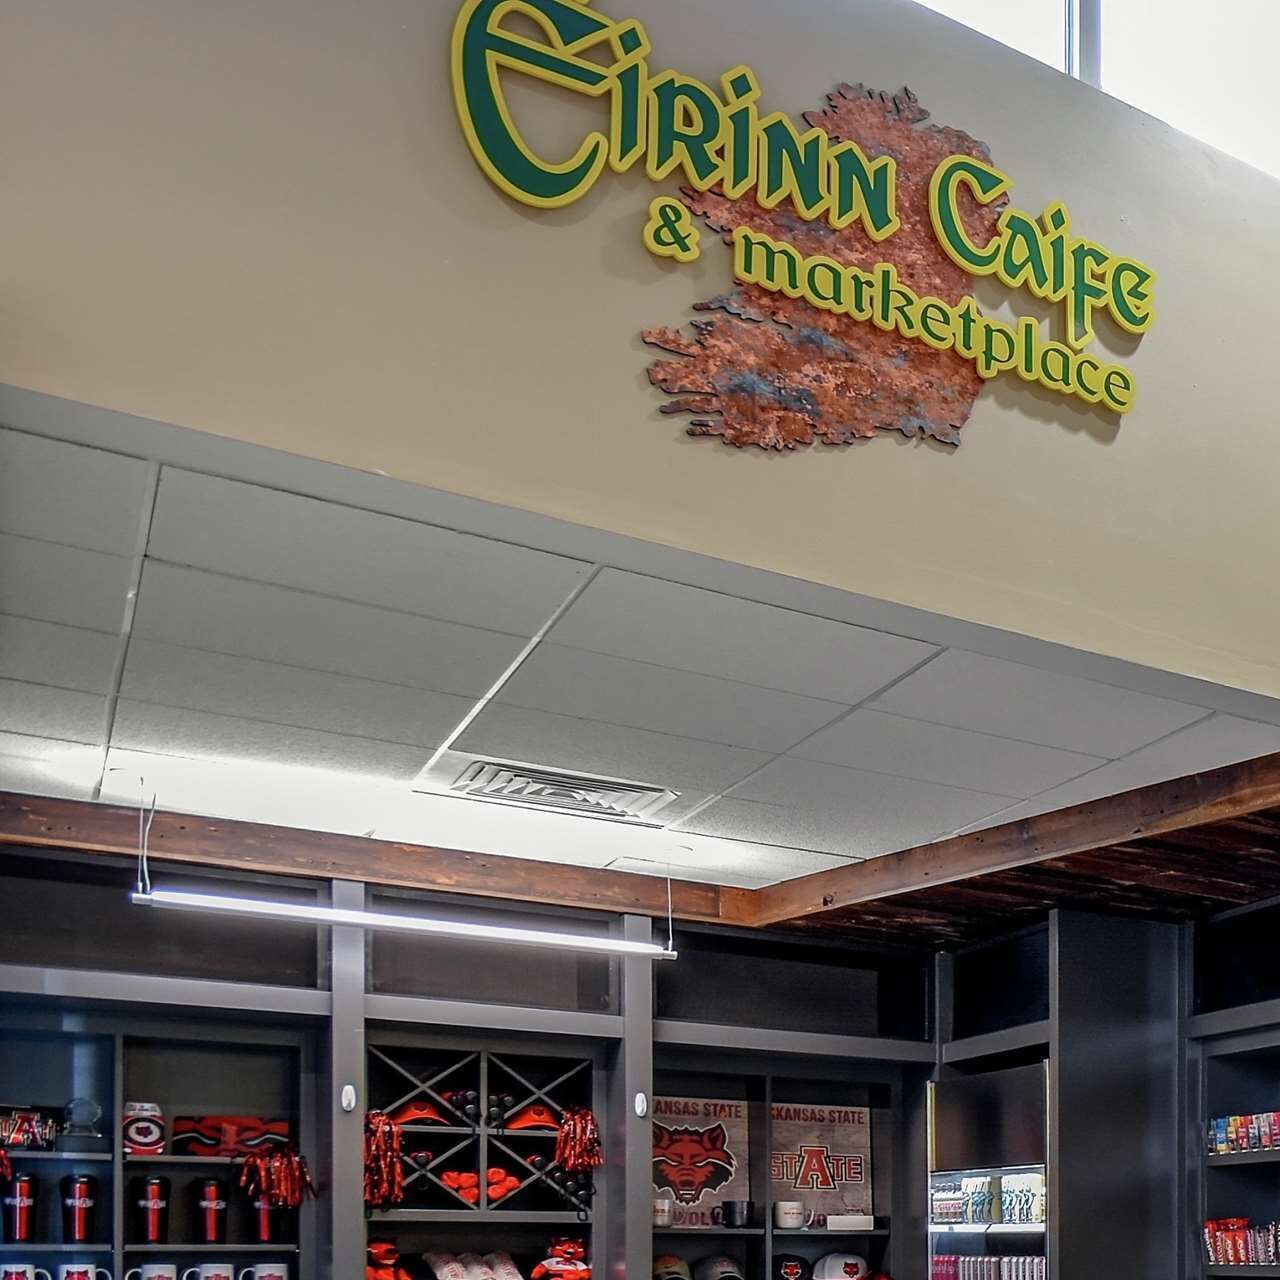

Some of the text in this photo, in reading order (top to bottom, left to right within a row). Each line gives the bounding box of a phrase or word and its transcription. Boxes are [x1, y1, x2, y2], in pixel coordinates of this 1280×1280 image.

[644, 197, 1134, 413] & marketplace
[703, 1102, 742, 1119] STATE
[828, 1109, 865, 1125] STATE
